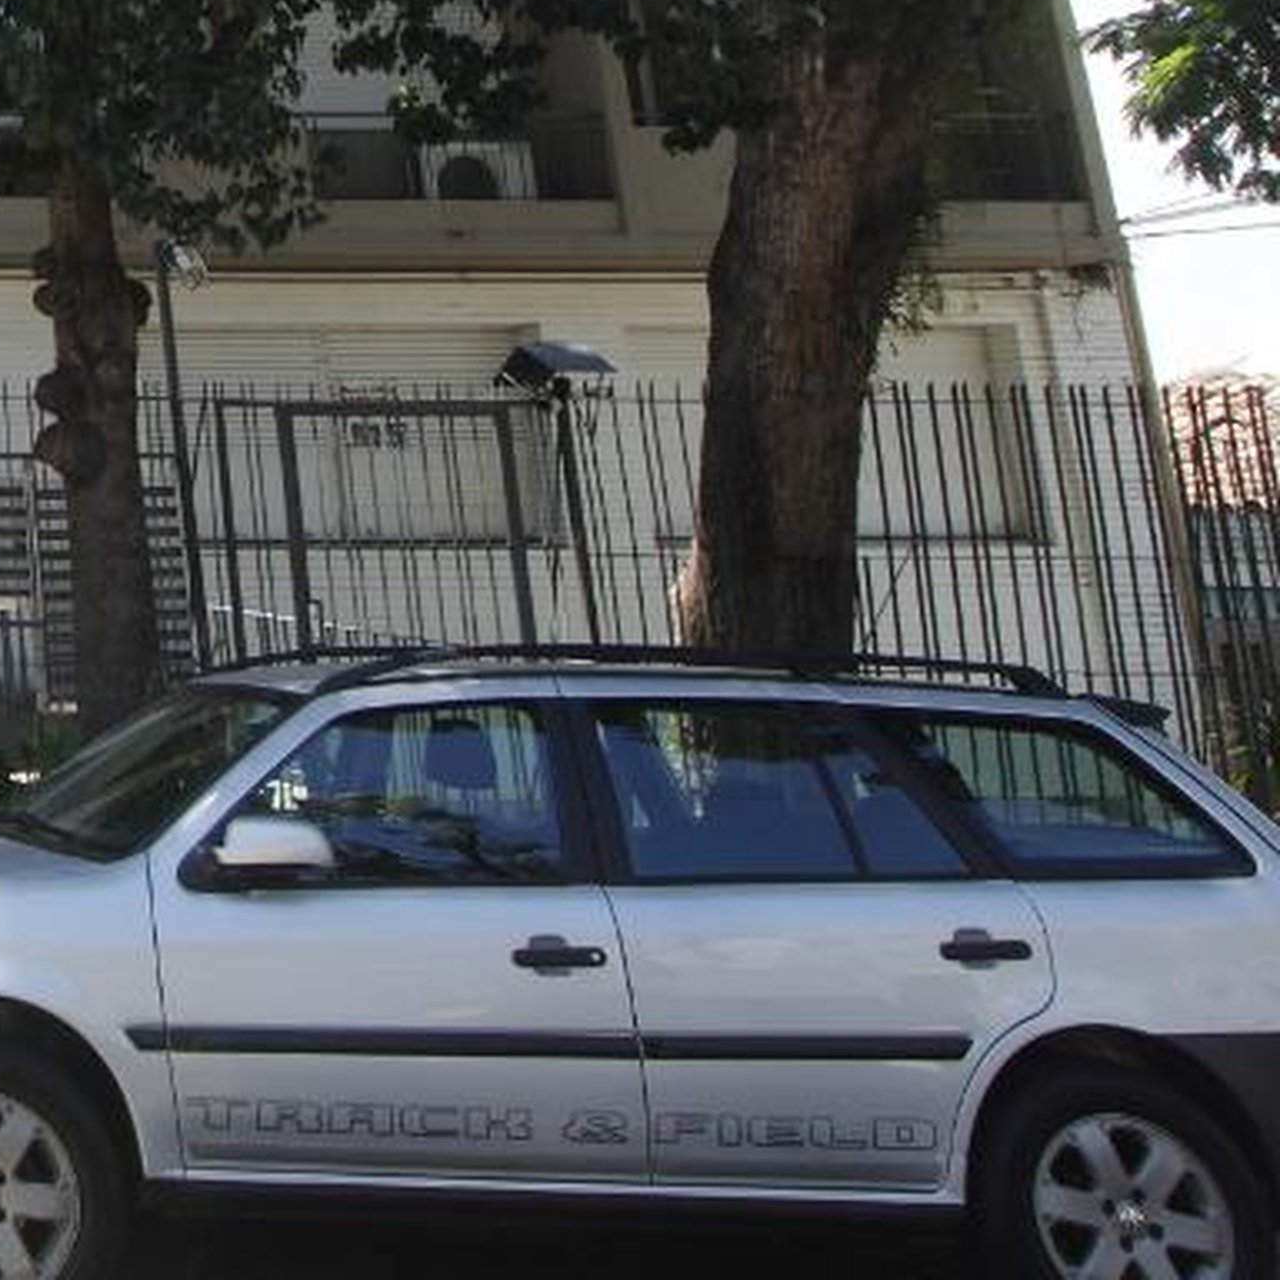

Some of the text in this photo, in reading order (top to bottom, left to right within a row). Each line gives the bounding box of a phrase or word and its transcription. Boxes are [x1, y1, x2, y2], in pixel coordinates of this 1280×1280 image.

[186, 1095, 938, 1151] TRACK & FIELD
